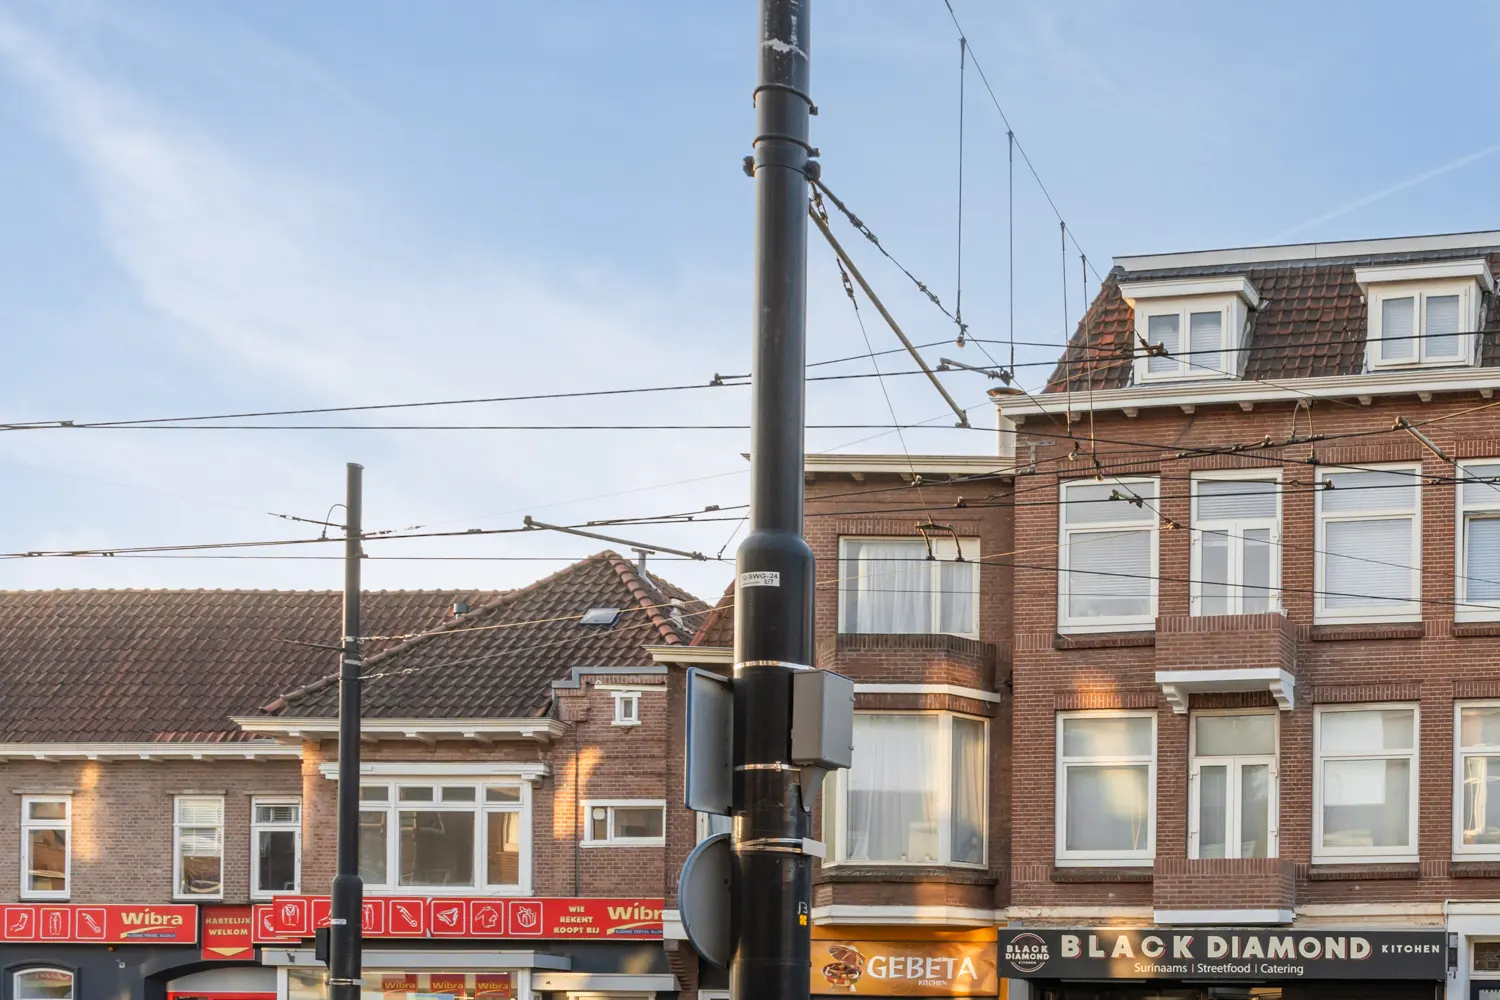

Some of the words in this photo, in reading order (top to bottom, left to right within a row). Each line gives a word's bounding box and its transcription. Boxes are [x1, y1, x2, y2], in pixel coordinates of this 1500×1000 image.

[607, 902, 664, 920] Wibr
[120, 908, 183, 925] Wibra
[205, 916, 251, 925] HARTELIJK
[208, 928, 249, 936] WELKOM
[586, 926, 600, 934] BIJ
[1006, 944, 1049, 953] BLACK
[1061, 935, 1195, 959] BLACK
[1207, 935, 1373, 960] DIAMOND
[1381, 944, 1440, 953] KITCHEN
[867, 955, 978, 980] GEBETA
[1134, 963, 1188, 973] Surinaams
[1197, 963, 1250, 974] Streetfood
[1260, 964, 1304, 975] Catering
[384, 980, 416, 989] Wibra
[432, 980, 464, 989] Wibra
[477, 980, 509, 990] Wibra
